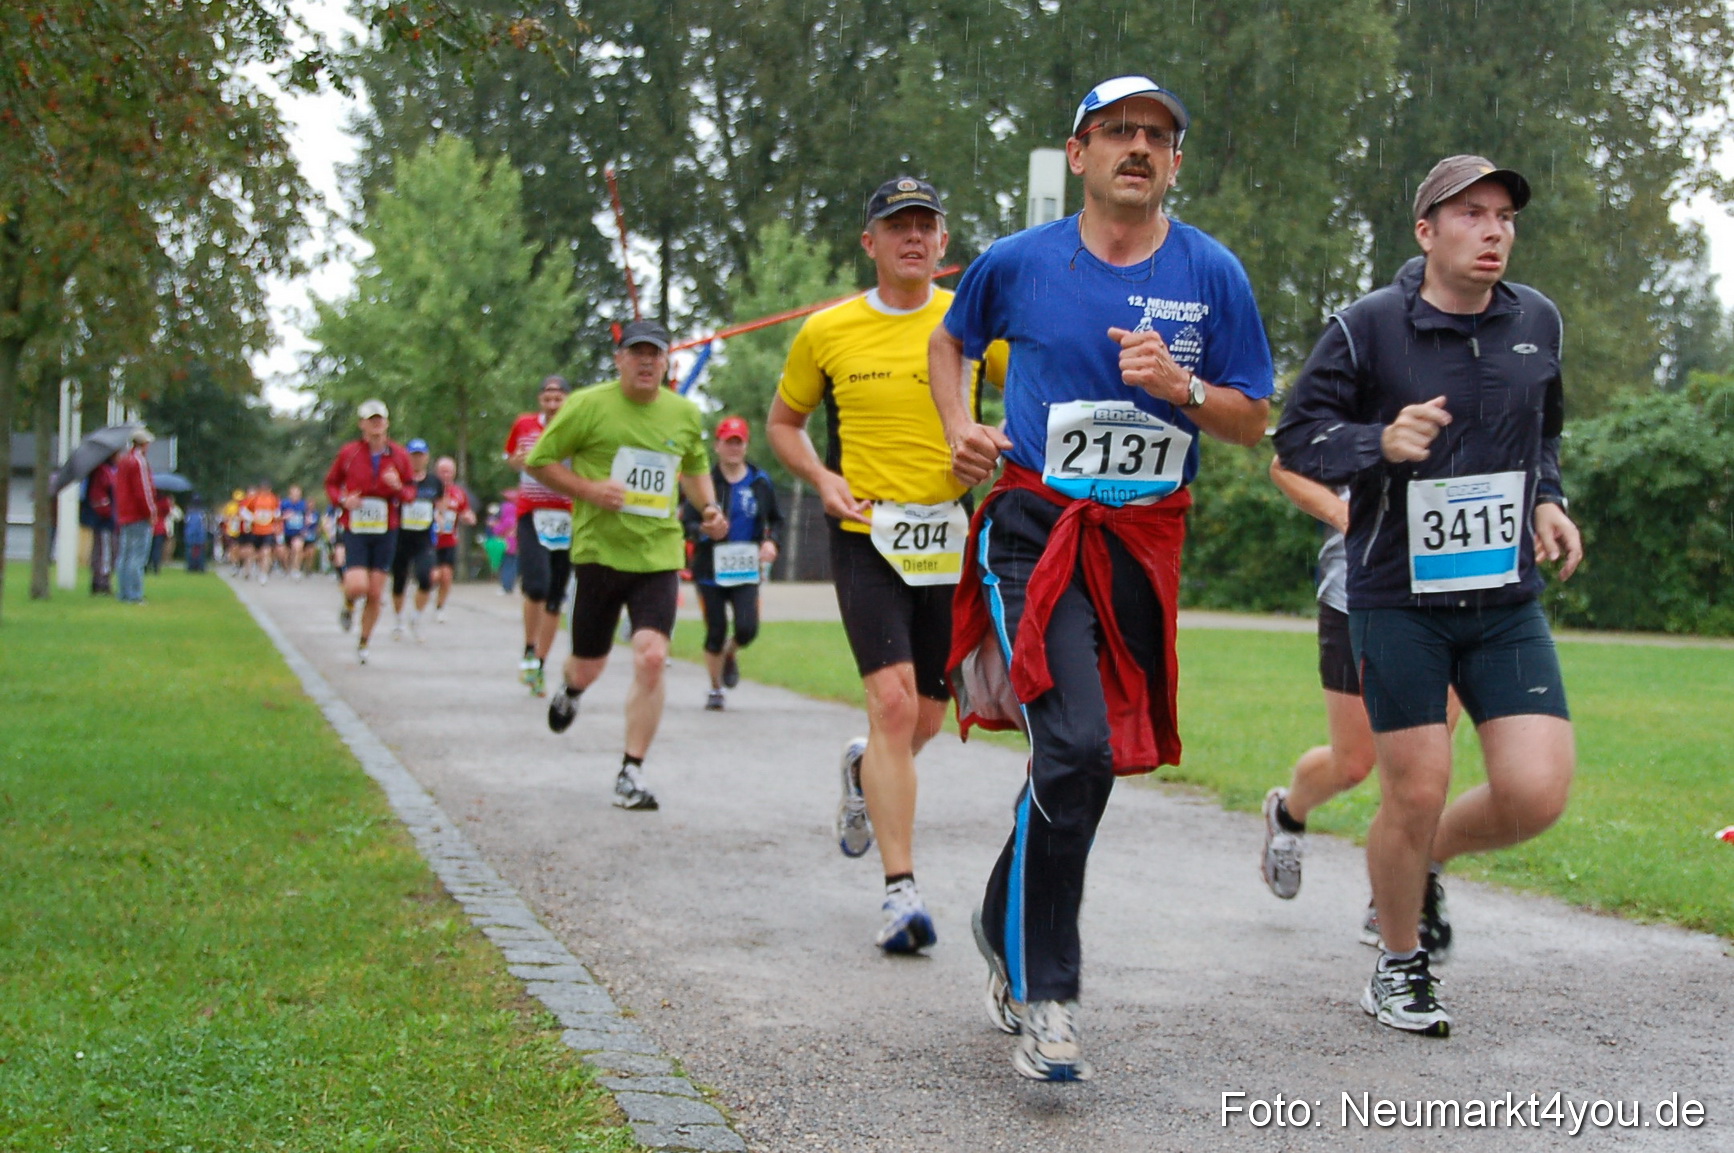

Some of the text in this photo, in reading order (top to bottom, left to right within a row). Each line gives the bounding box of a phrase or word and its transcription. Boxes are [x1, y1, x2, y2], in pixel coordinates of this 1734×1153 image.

[1127, 295, 1146, 307] 12.
[1143, 306, 1203, 323] STADTLAUF
[848, 371, 892, 384] Dieter
[1093, 408, 1149, 423] BOCK
[1061, 430, 1172, 475] 2131
[626, 467, 665, 492] 408
[893, 521, 949, 550] 204
[1423, 503, 1515, 551] 3415
[903, 559, 939, 572] Dieter
